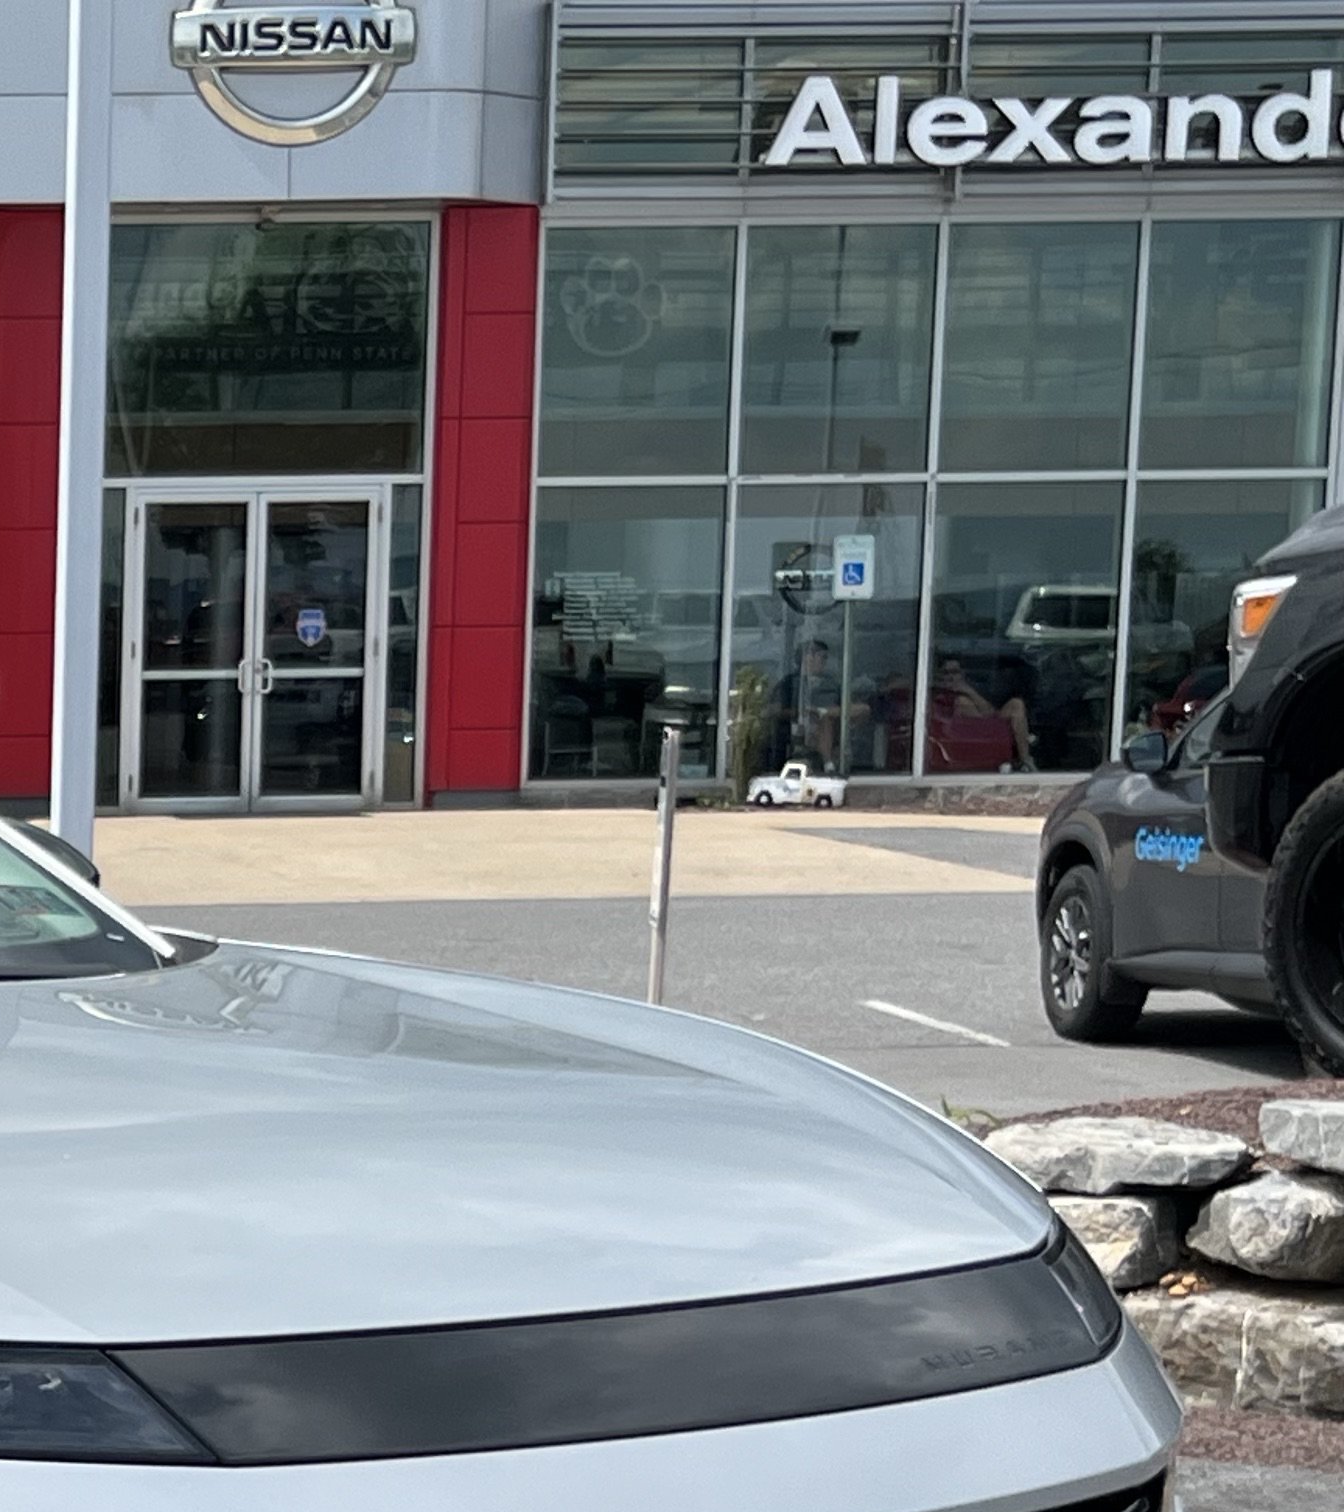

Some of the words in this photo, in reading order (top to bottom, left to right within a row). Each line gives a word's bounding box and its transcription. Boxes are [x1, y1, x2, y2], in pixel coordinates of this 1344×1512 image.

[198, 17, 395, 58] NISSAN
[764, 69, 1344, 167] Alexand
[289, 346, 342, 361] PENN
[352, 345, 412, 361] STATE
[1134, 825, 1205, 872] Geisinger
